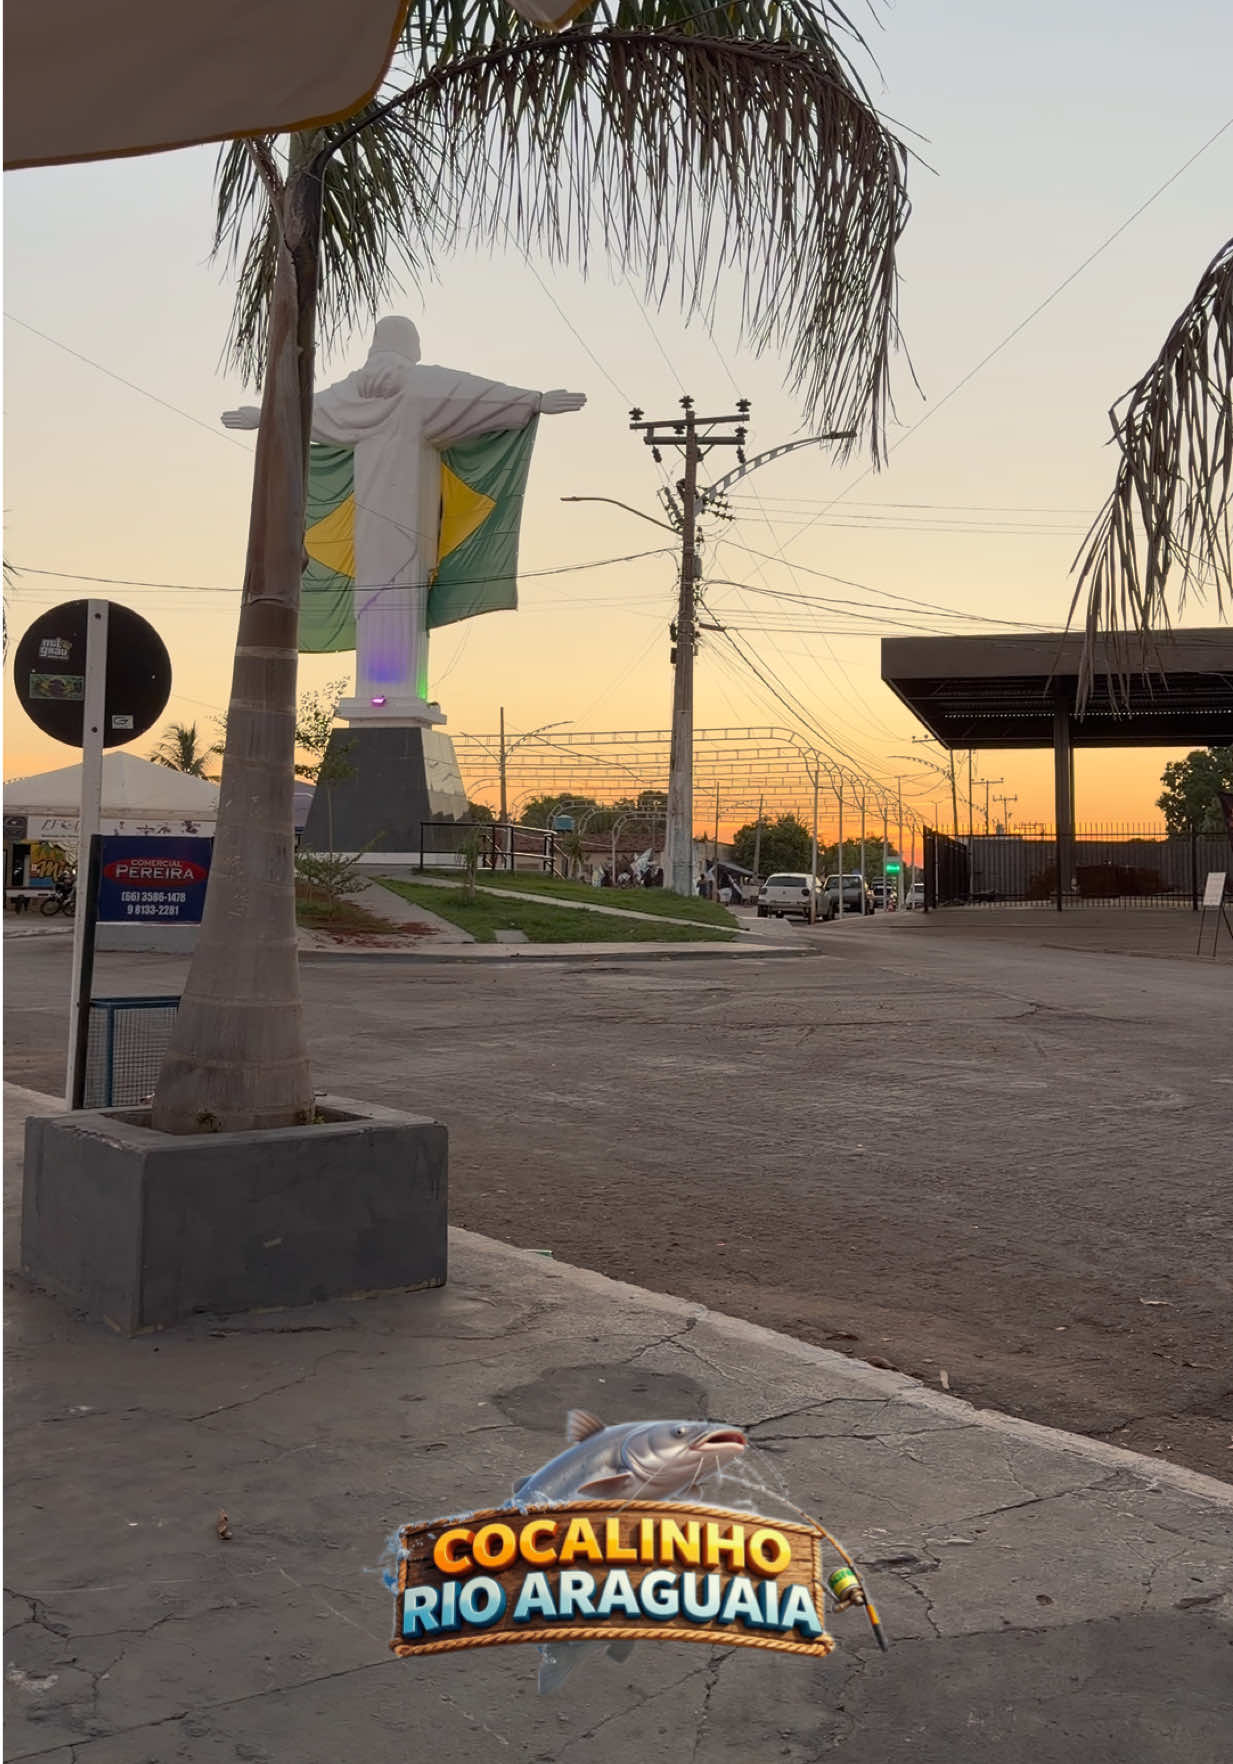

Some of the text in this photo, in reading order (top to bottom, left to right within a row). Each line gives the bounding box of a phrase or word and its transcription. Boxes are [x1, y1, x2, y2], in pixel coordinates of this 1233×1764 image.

[130, 859, 183, 867] COMERCIAL
[115, 864, 194, 879] PEREIRA
[127, 904, 134, 915] 9
